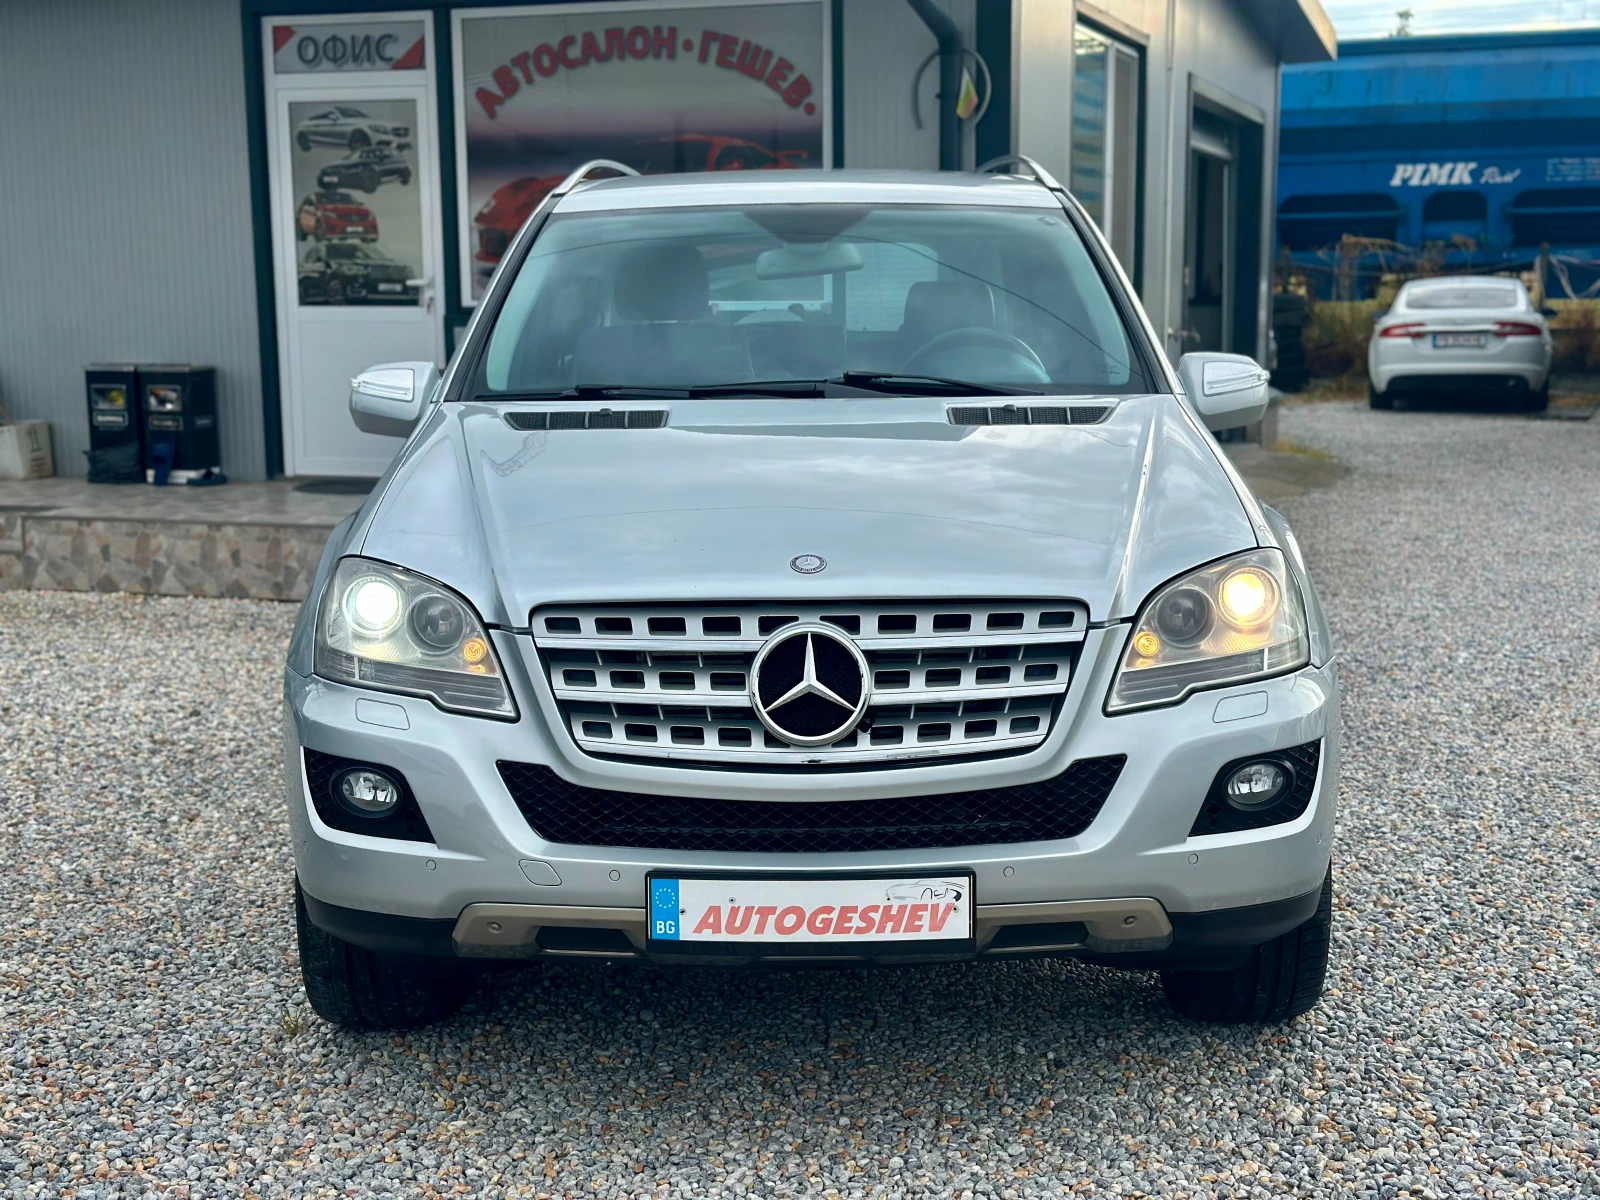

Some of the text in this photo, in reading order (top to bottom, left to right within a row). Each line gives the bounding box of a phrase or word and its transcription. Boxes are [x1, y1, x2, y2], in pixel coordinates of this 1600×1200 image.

[297, 34, 396, 66] ОФИС
[475, 26, 812, 119] АВТОСАЛОН ГЕШЕВ
[1389, 161, 1478, 187] PIMK
[656, 920, 676, 934] BG
[692, 902, 955, 936] AUTOGESHEV
